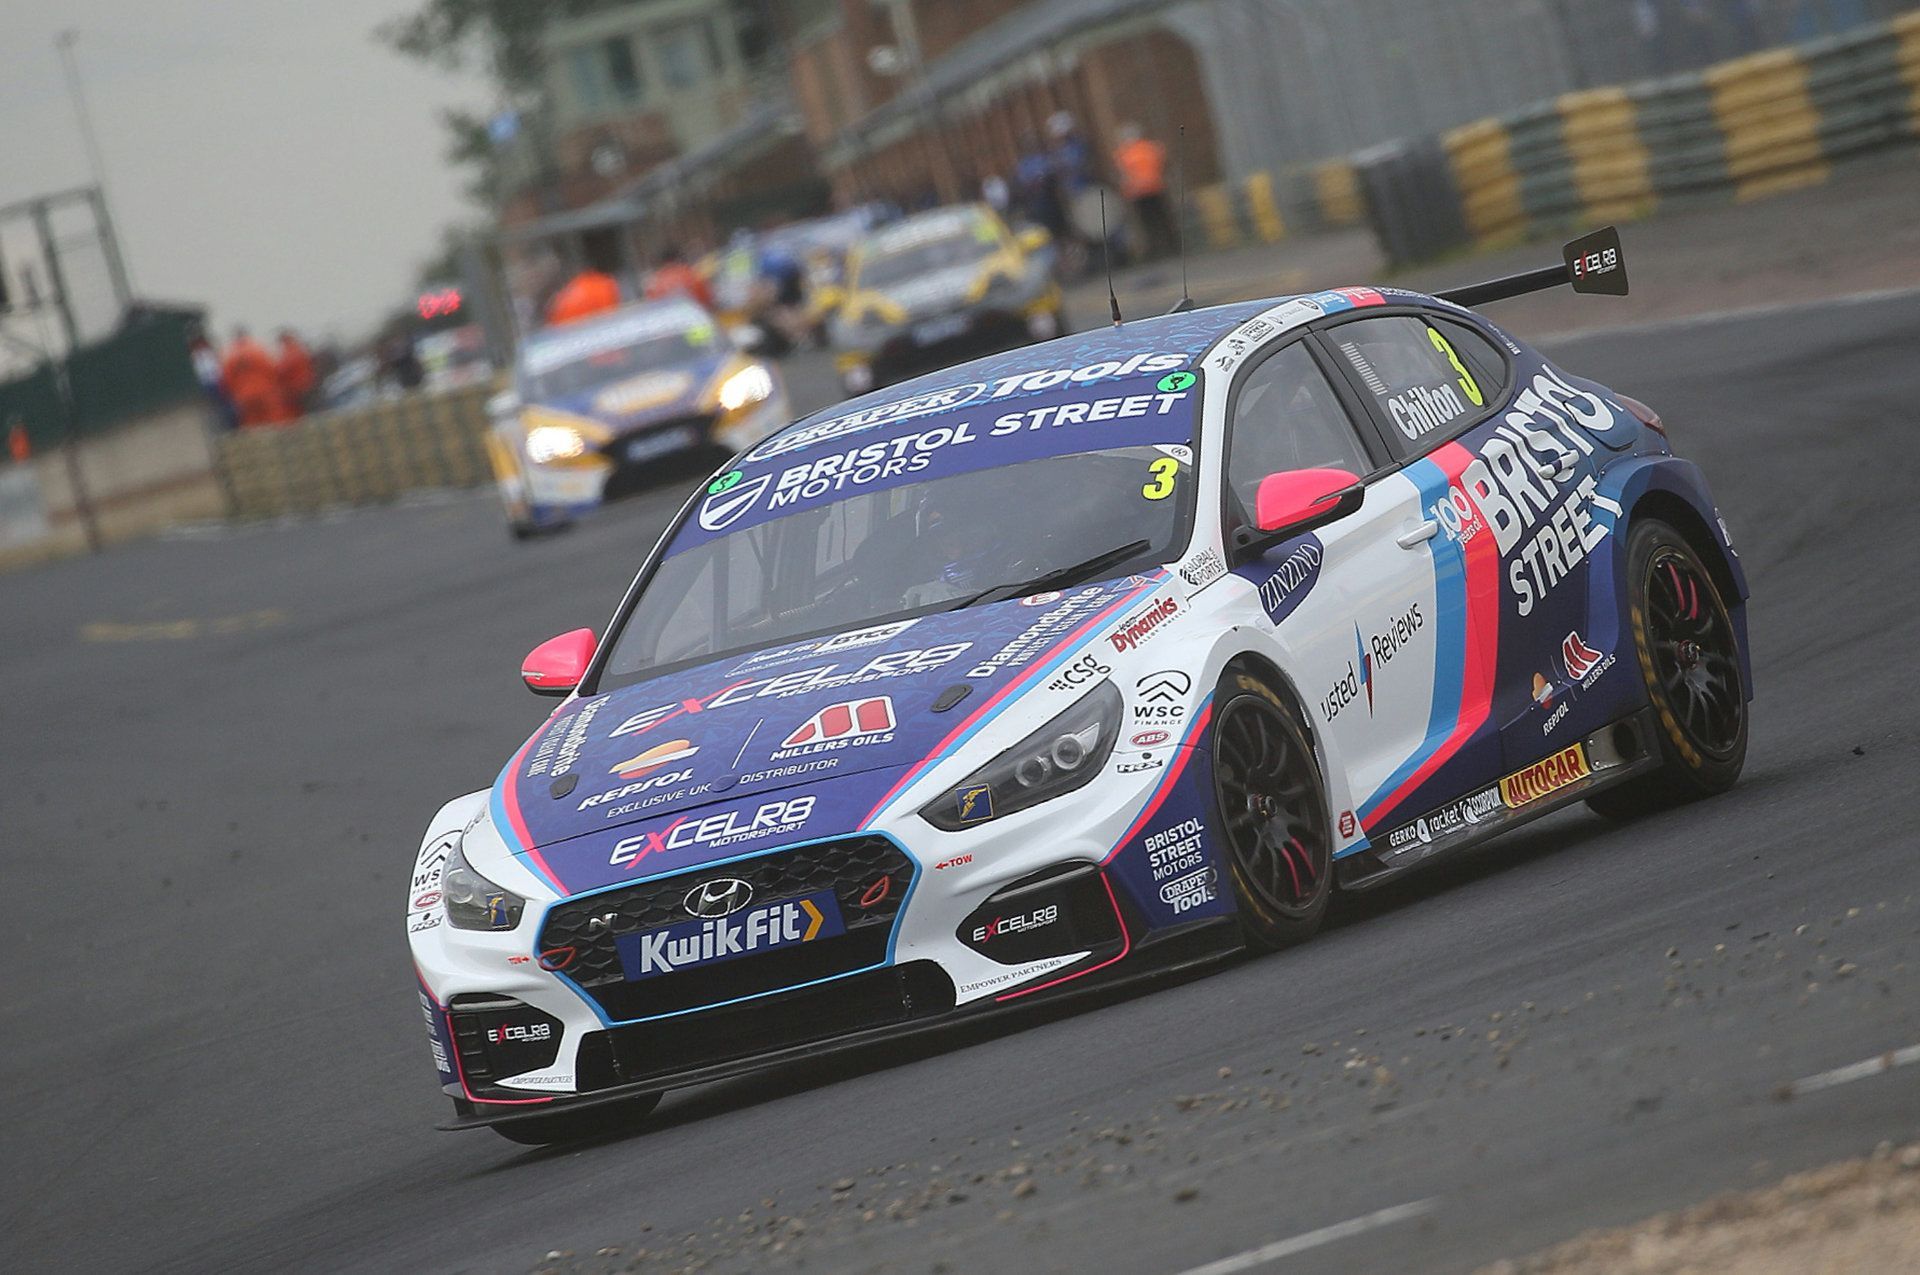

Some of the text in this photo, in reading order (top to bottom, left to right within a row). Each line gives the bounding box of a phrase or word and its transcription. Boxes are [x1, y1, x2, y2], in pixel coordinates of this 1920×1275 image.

[1427, 327, 1483, 406] 3
[769, 352, 1189, 451] DRAPER Tools
[1387, 383, 1465, 440] Chilton
[775, 392, 1187, 492] BRISTOL STREET
[766, 452, 932, 511] MOTORS
[1142, 457, 1179, 500] 3
[1430, 486, 1473, 541] 100
[1510, 474, 1623, 617] STREET
[1260, 544, 1320, 613] ZINZINO
[1111, 597, 1178, 653] Dynamics
[1371, 602, 1424, 669] Reviews
[608, 641, 974, 738] EXCELR8
[776, 663, 945, 700] MOTORSPORT
[1320, 660, 1358, 722] usted
[1134, 705, 1185, 719] WSC
[1134, 718, 1182, 726] FINANCE
[1542, 701, 1569, 736] REPSOL
[769, 732, 895, 762] MILLERS OILS
[577, 767, 695, 812] REPSOL
[606, 758, 839, 818] EXCLUSIVE UK DISTRIBUTOR
[1507, 748, 1583, 806] AUTOCAR
[609, 796, 816, 870] EXCELR8
[708, 821, 806, 849] MOTORSPORT
[1144, 817, 1204, 853] BRISTOL
[1429, 804, 1461, 833] rocket
[948, 854, 973, 867] TOW
[1149, 834, 1202, 867] STREET
[1152, 852, 1203, 881] MOTORS
[414, 869, 441, 887] WS
[973, 905, 1058, 943] EXCELR8
[960, 958, 1063, 994] EMPOWER PARTNERS
[488, 1023, 550, 1045] EXCELR8
